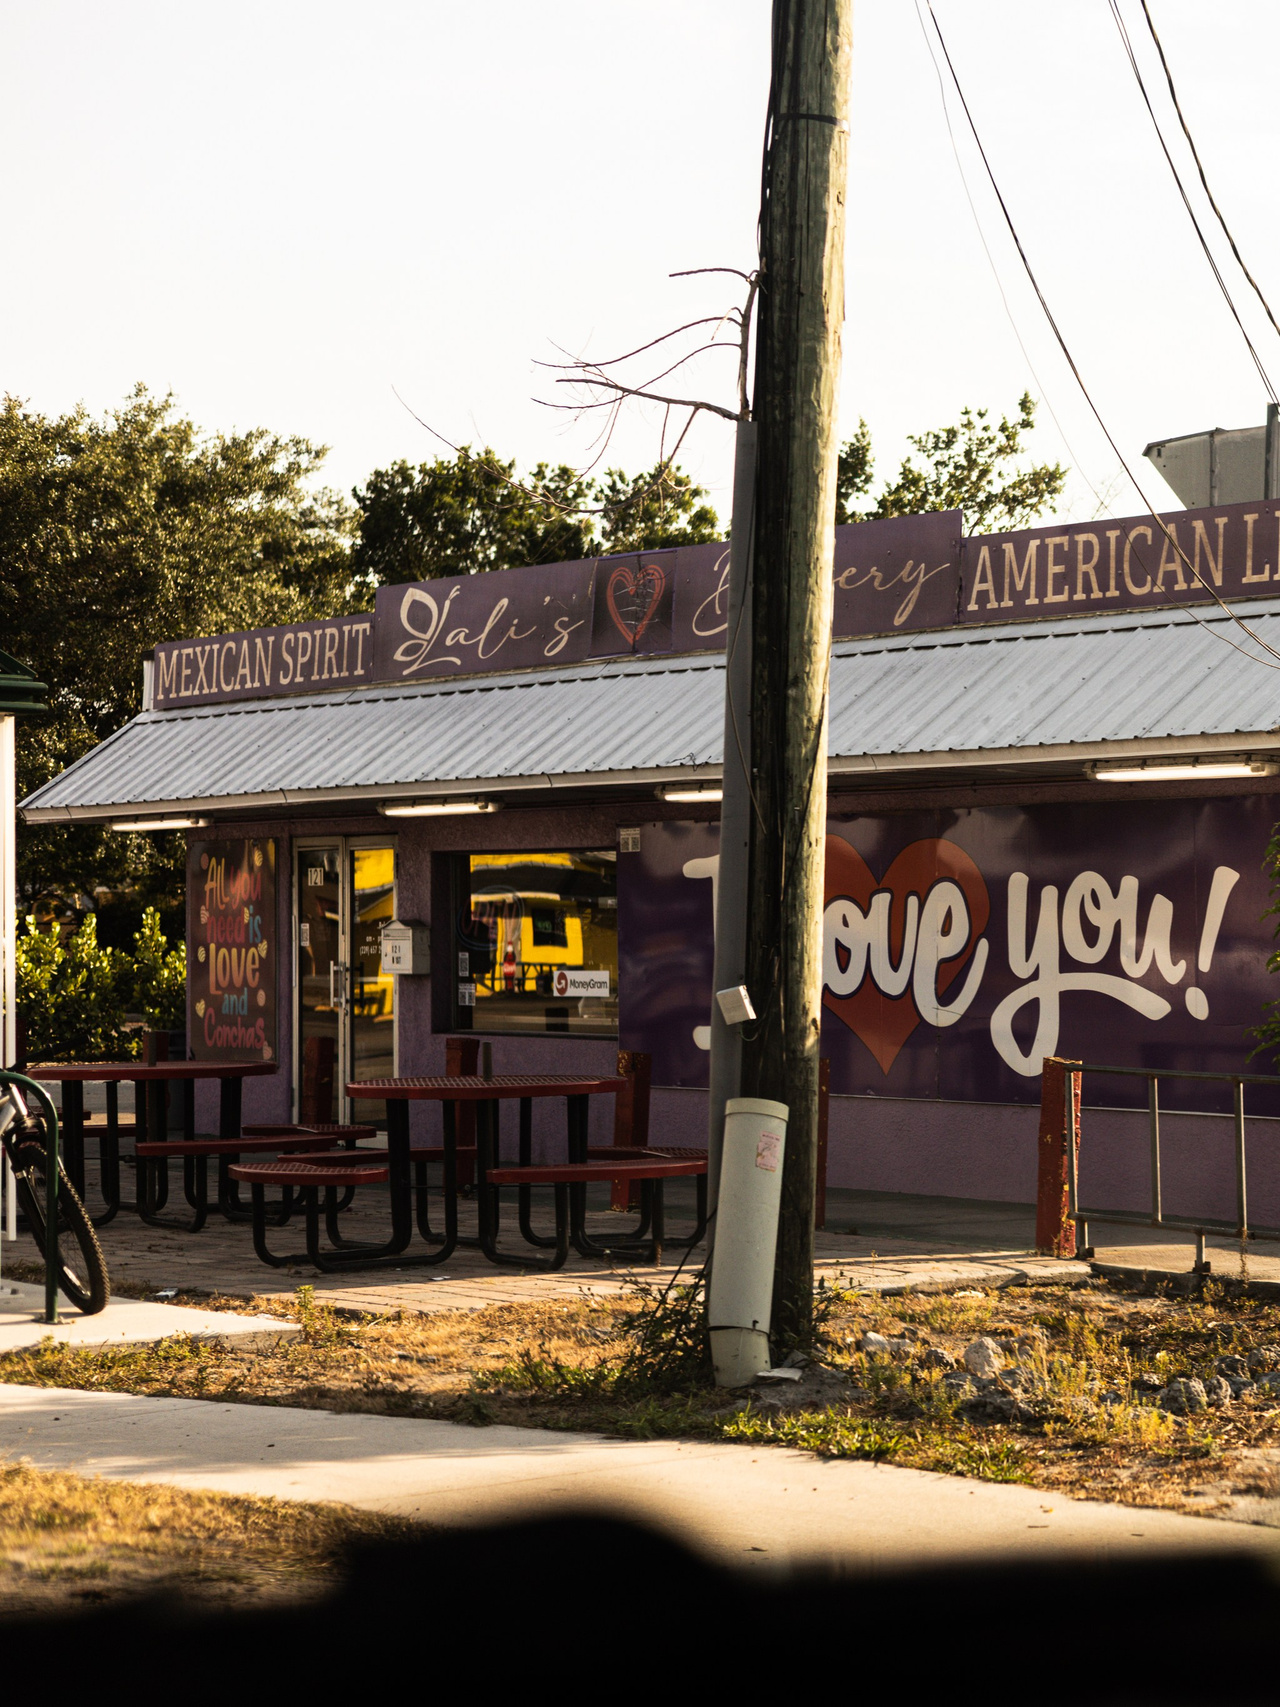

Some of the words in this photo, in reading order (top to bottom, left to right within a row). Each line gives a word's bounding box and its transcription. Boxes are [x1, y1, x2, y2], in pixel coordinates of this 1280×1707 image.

[967, 516, 1229, 611] AMERICAN
[157, 636, 275, 700] MEXICAN
[279, 622, 371, 686] SPIRIT
[230, 865, 262, 910] you
[309, 868, 323, 885] 121
[206, 905, 245, 944] need
[250, 904, 262, 944] is
[391, 945, 401, 954] 121
[569, 978, 608, 991] MoneyGram
[990, 865, 1240, 1078] you!
[222, 987, 248, 1016] and
[204, 1007, 265, 1049] Conchas
